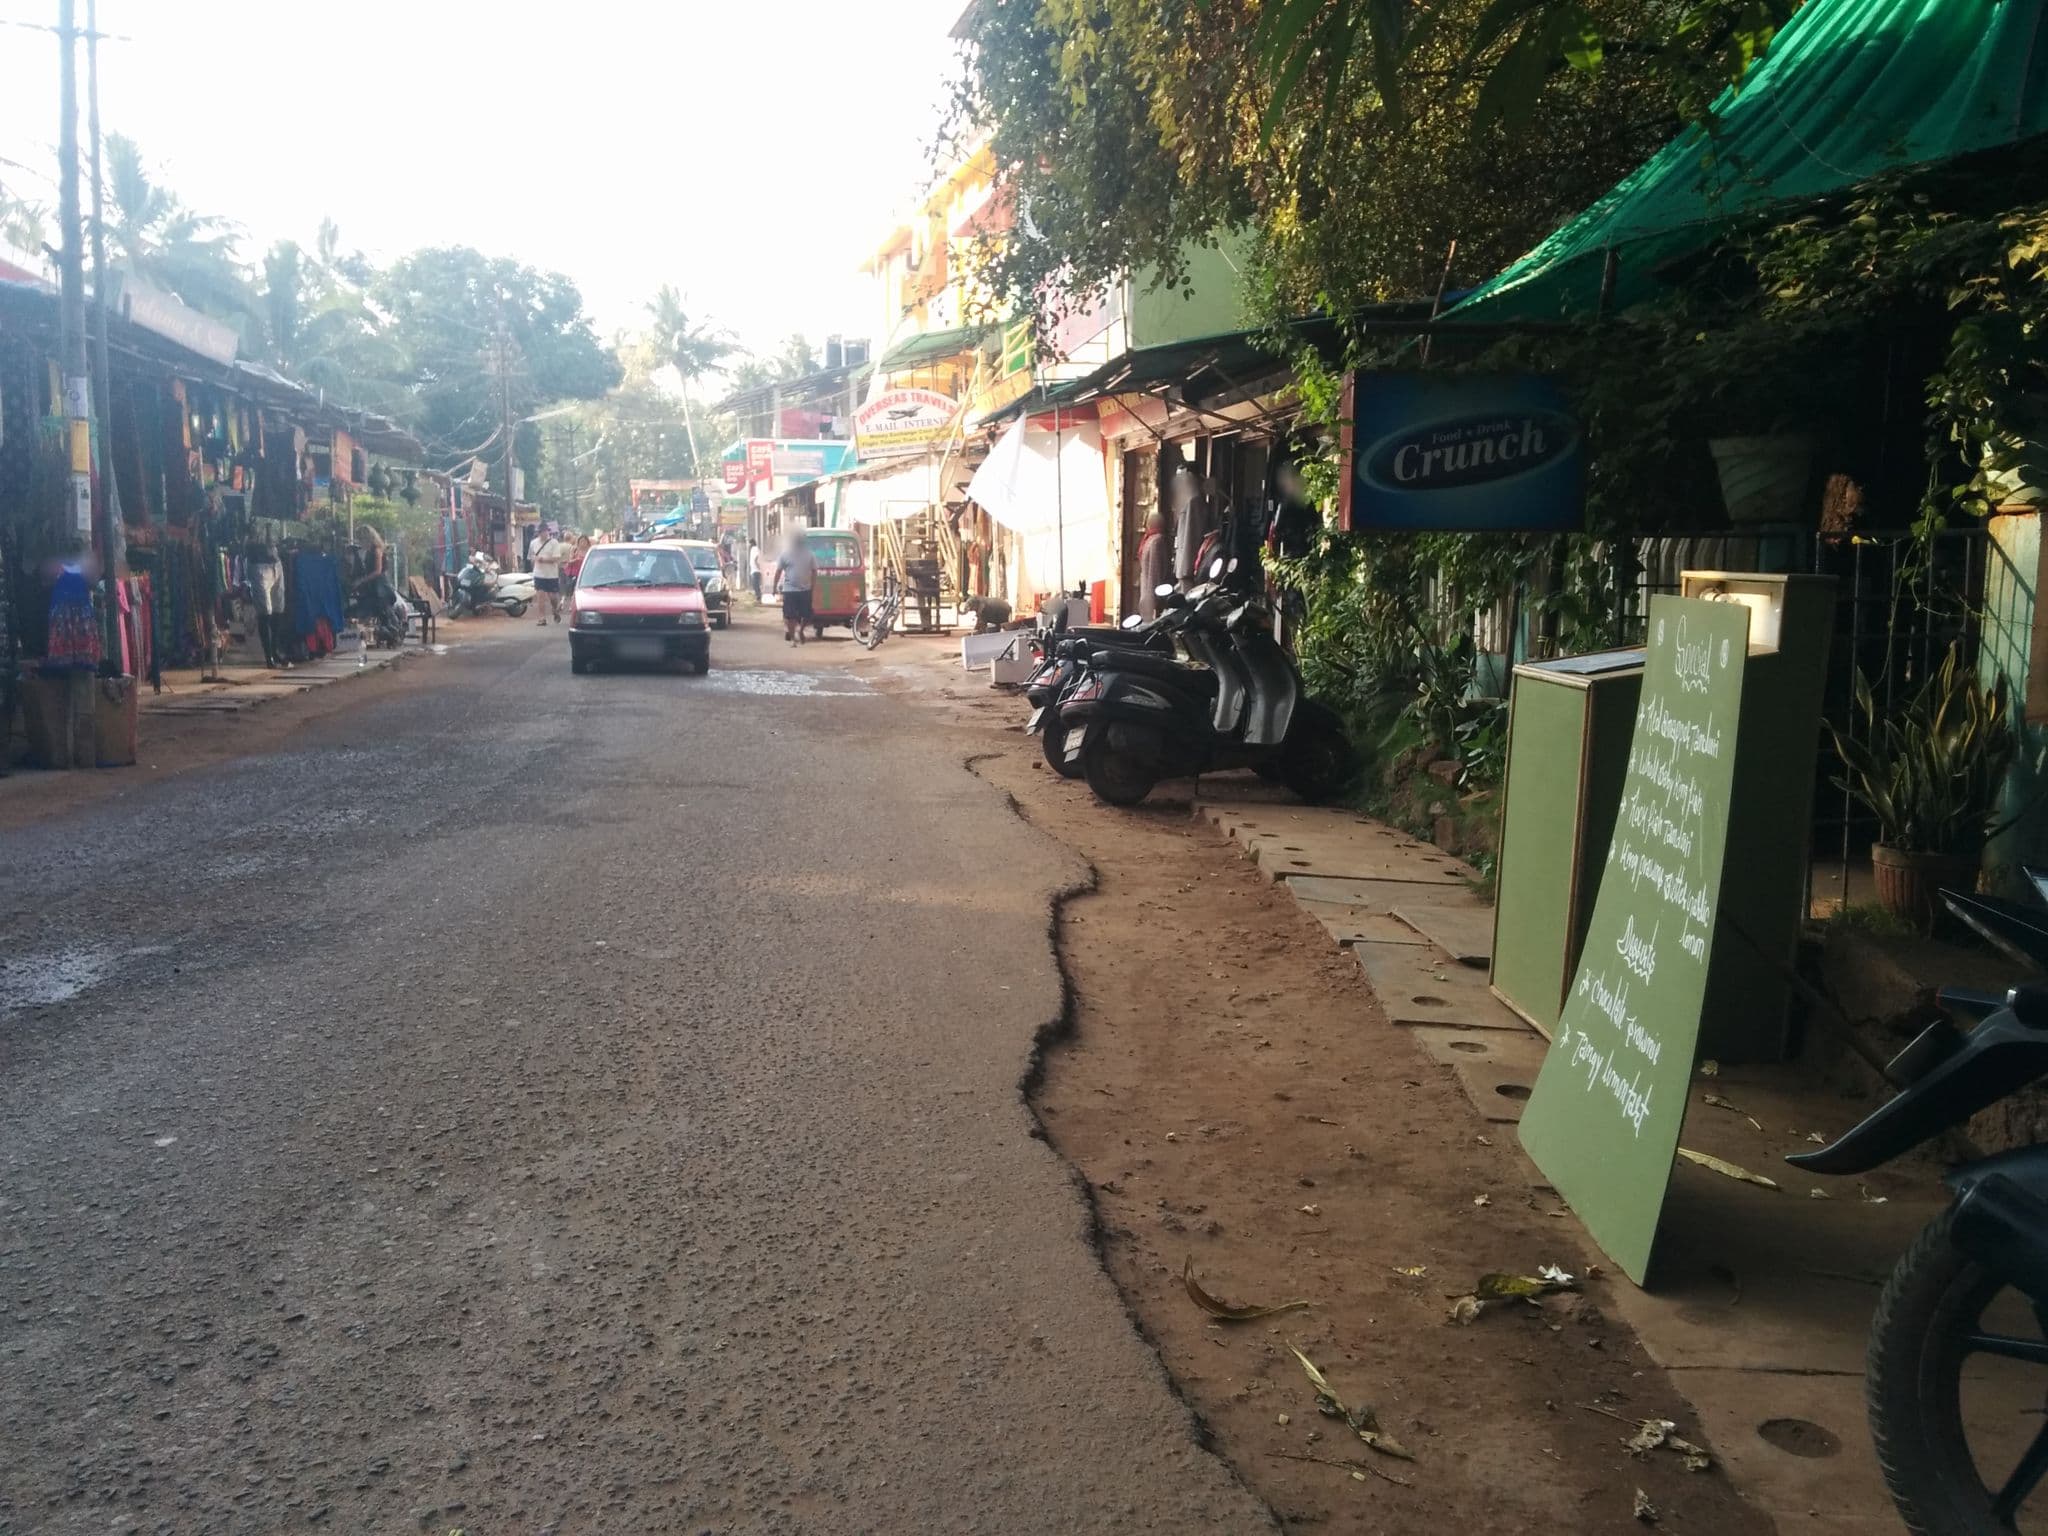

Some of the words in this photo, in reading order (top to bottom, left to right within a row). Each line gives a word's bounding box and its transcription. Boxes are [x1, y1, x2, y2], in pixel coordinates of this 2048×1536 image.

[859, 392, 908, 425] OVERSEAS
[1432, 428, 1462, 445] Food
[1476, 420, 1512, 436] Drink
[1393, 420, 1546, 482] Crunch
